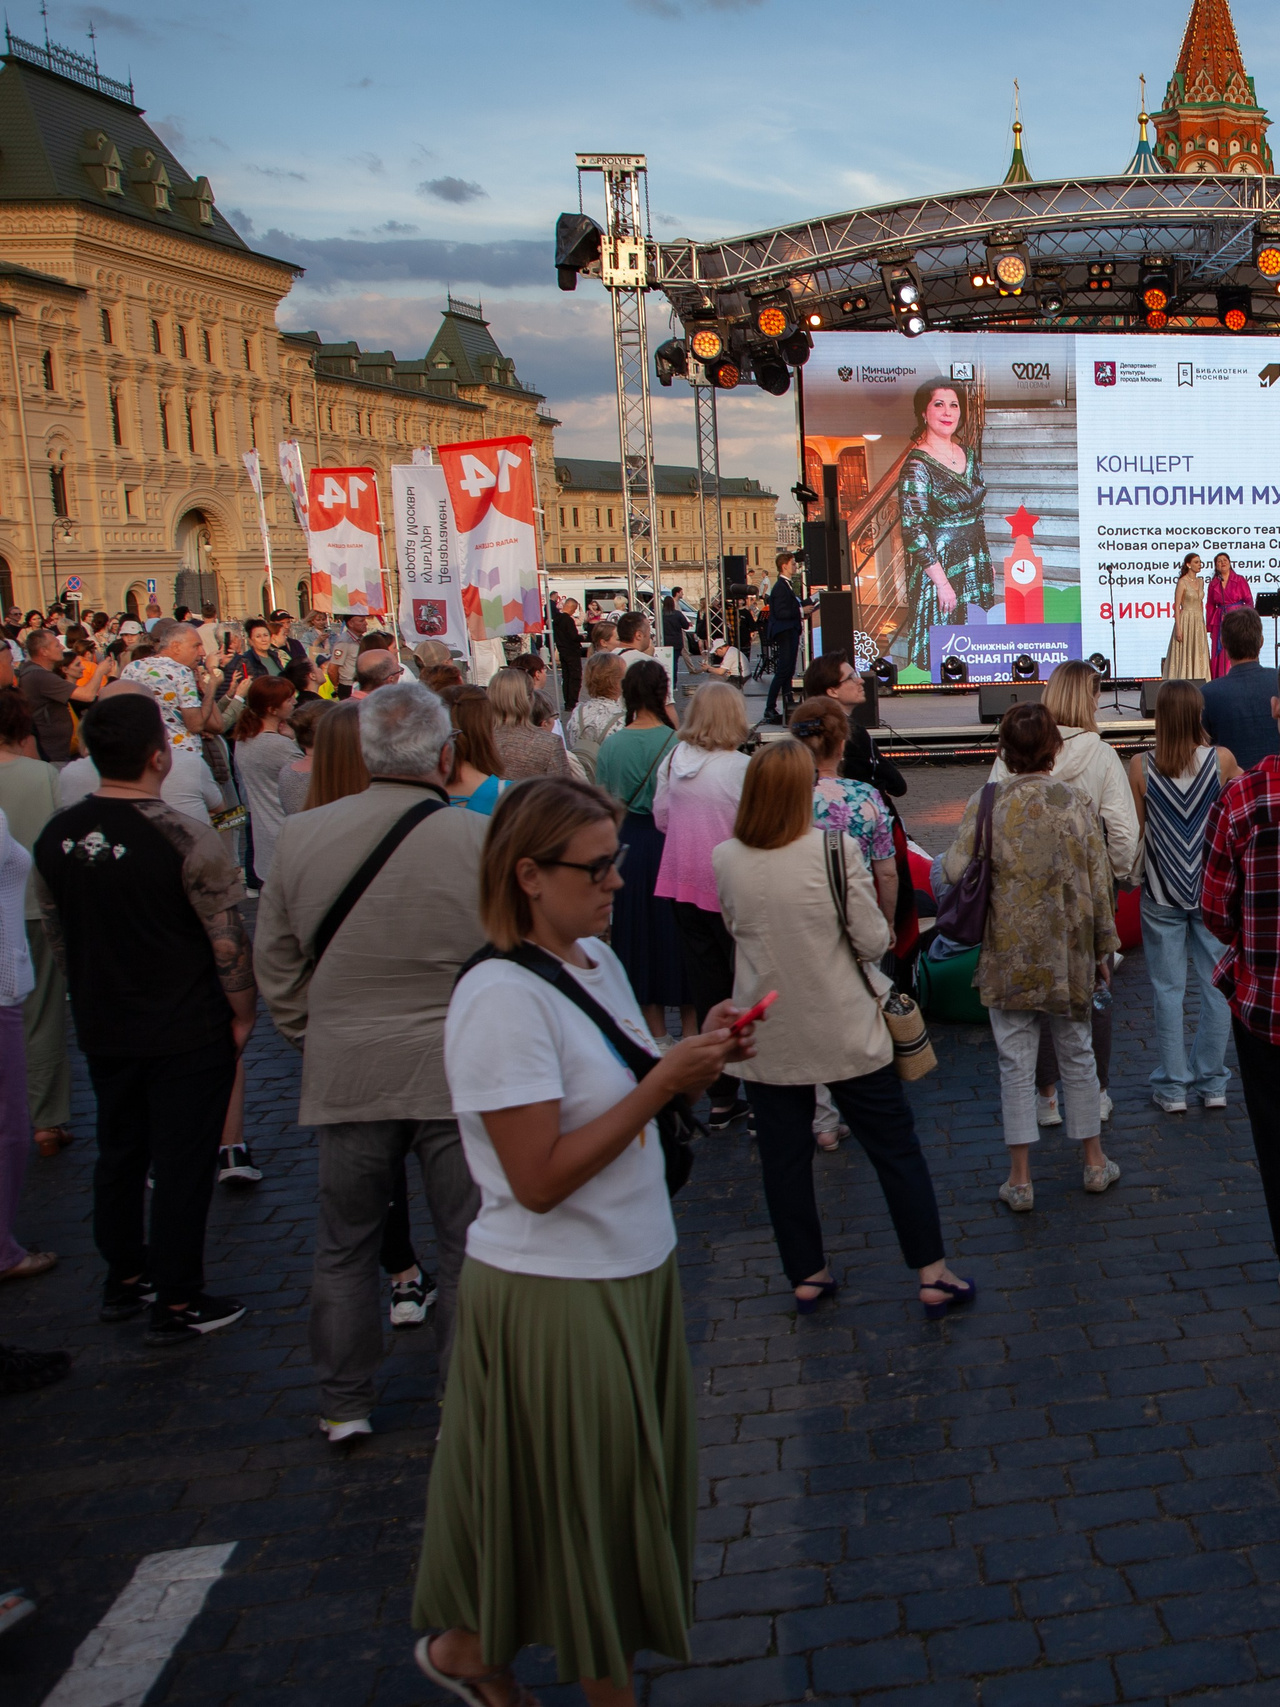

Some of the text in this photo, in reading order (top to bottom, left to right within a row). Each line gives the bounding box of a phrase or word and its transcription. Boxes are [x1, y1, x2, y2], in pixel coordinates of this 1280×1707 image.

[596, 157, 631, 165] PROLYTE
[862, 365, 917, 377] Минцифры
[1012, 362, 1051, 380] 2024
[1119, 362, 1157, 370] Департамент
[862, 375, 897, 383] России
[1096, 455, 1194, 475] КОНЦЕРТ
[1097, 485, 1244, 506] НАПОЛНИМ
[1097, 525, 1162, 536] Солистка
[1165, 526, 1251, 535] московского
[1097, 540, 1148, 551] «Новая
[1151, 541, 1200, 552] опера»
[1202, 539, 1266, 550] Светлана
[1098, 562, 1106, 570] и
[1110, 561, 1170, 572] молодые
[1098, 574, 1144, 587] София
[1099, 602, 1113, 620] 8
[941, 633, 1069, 653] 10 КНИЖНЫЙ ФЕСТИВАЛЬ
